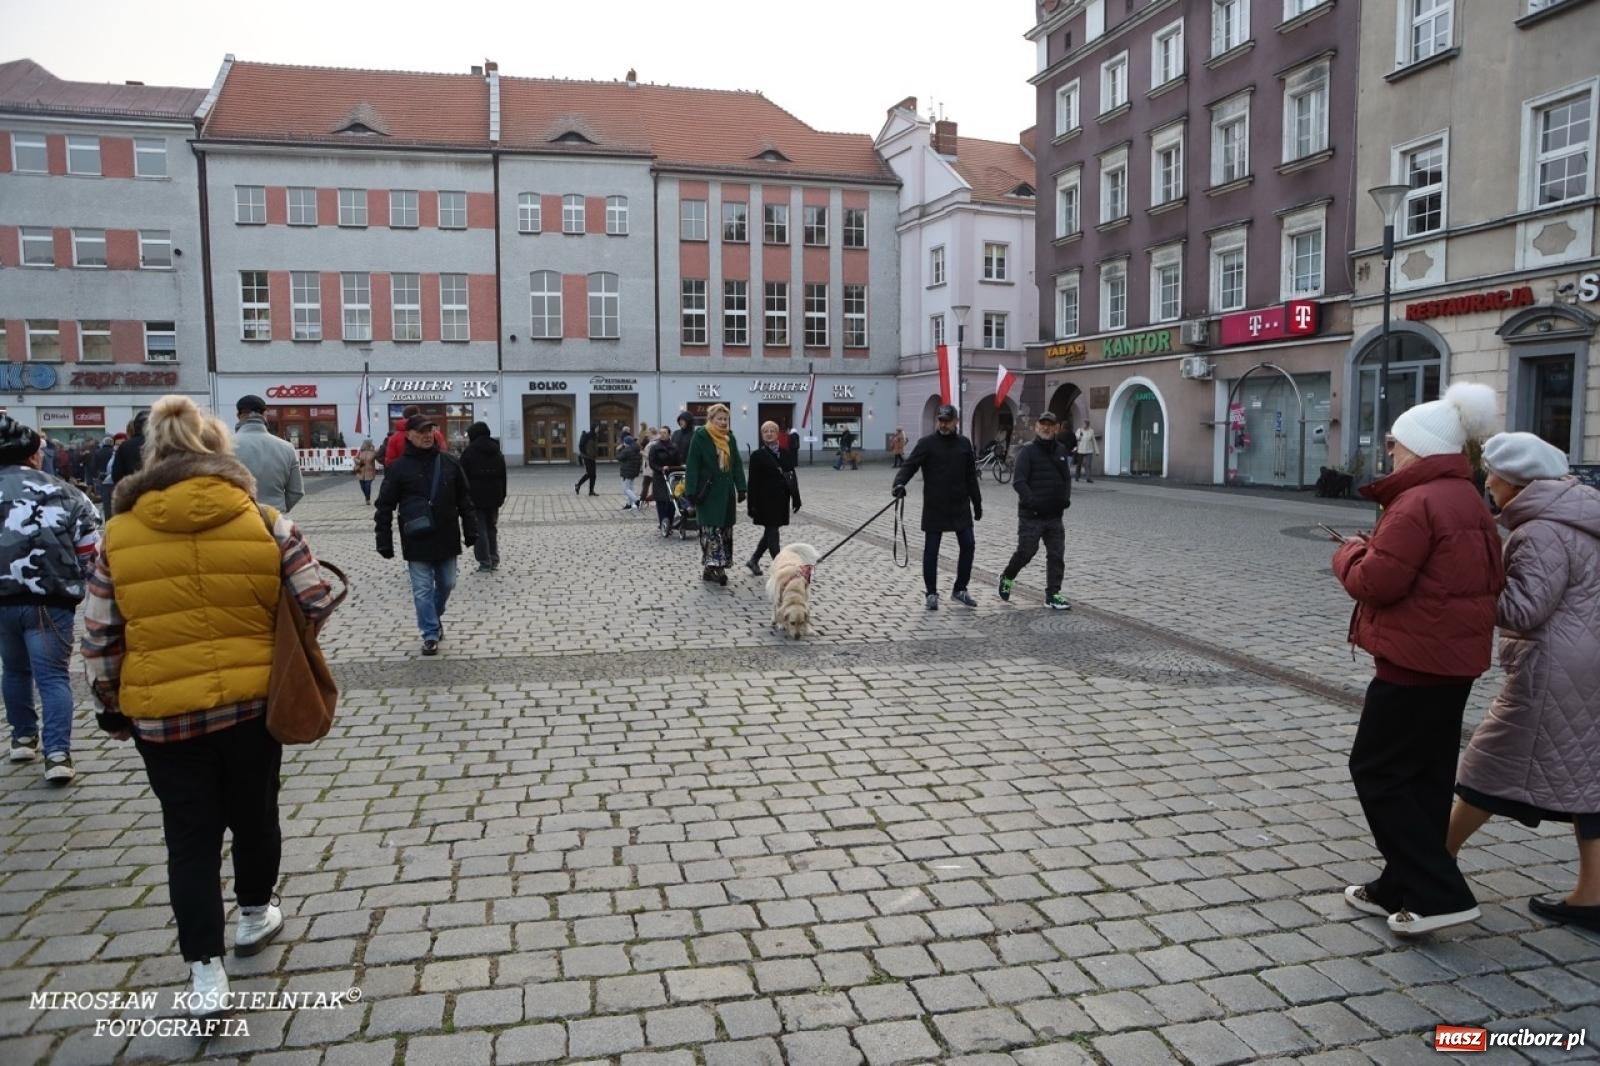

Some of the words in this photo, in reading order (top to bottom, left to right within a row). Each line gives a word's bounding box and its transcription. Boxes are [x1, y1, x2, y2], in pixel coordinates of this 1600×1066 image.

[1406, 286, 1534, 321] RESTAURACJA
[1296, 305, 1311, 329] T
[1102, 330, 1171, 358] KANTOR
[379, 377, 454, 391] JUBILER
[529, 381, 568, 391] BOLKO
[749, 380, 809, 391] JUBILER
